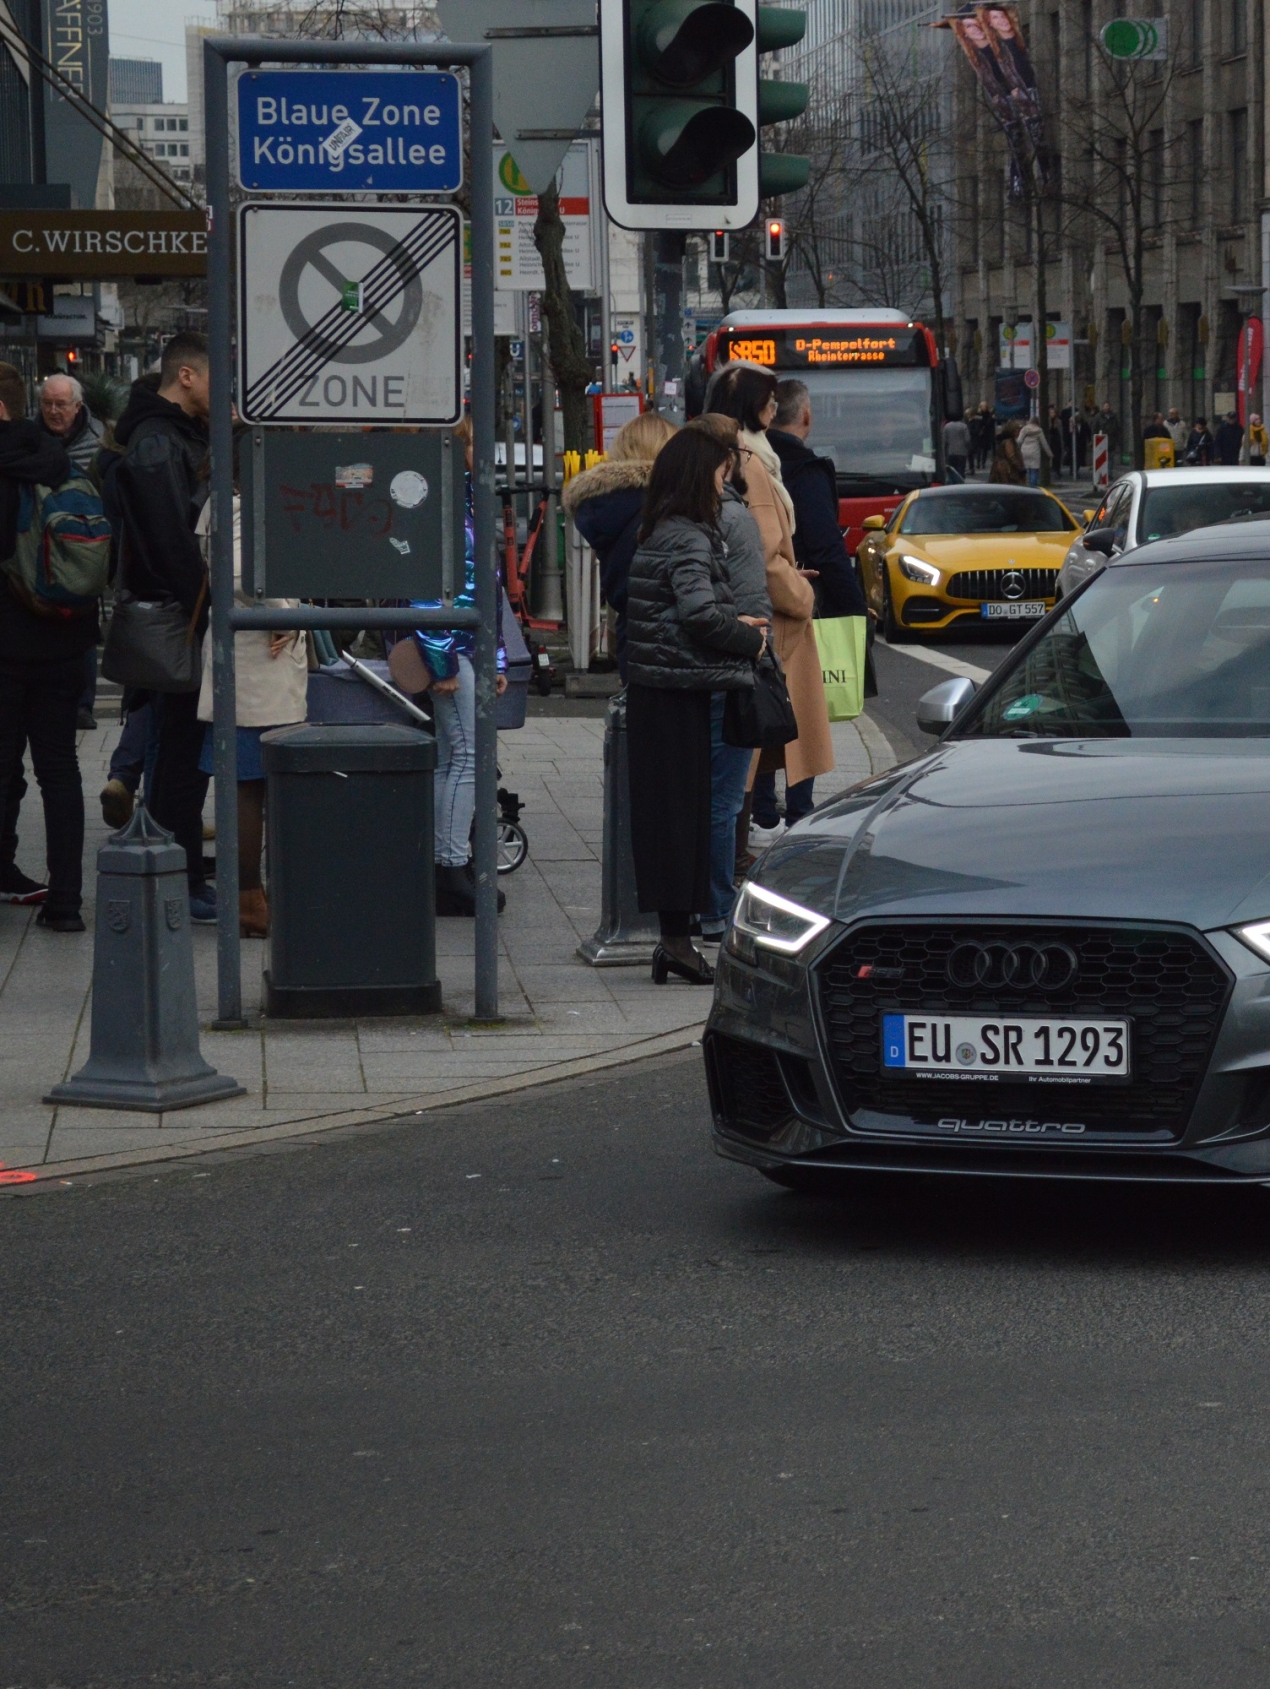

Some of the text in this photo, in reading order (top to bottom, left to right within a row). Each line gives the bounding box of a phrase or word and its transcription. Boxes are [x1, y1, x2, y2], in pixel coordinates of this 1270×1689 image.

[256, 97, 441, 125] Blaue Zone
[328, 124, 356, 152] UNFAIR
[253, 136, 447, 172] Königsallee
[495, 199, 513, 214] 12
[12, 229, 208, 254] C.WIRSCHKE
[510, 344, 520, 357] U
[808, 351, 885, 362] Rheinterrasse
[299, 375, 406, 408] ZONE
[988, 603, 1044, 615] DO GT 557
[822, 669, 847, 684] INI
[890, 1046, 899, 1058] D
[907, 1021, 1124, 1068] EU SR 1293
[916, 1071, 999, 1081] WWW.JACOBS-GRUPPE.DE
[1028, 1075, 1092, 1085] Ihr Automobilpartner
[937, 1117, 1087, 1134] quattro
